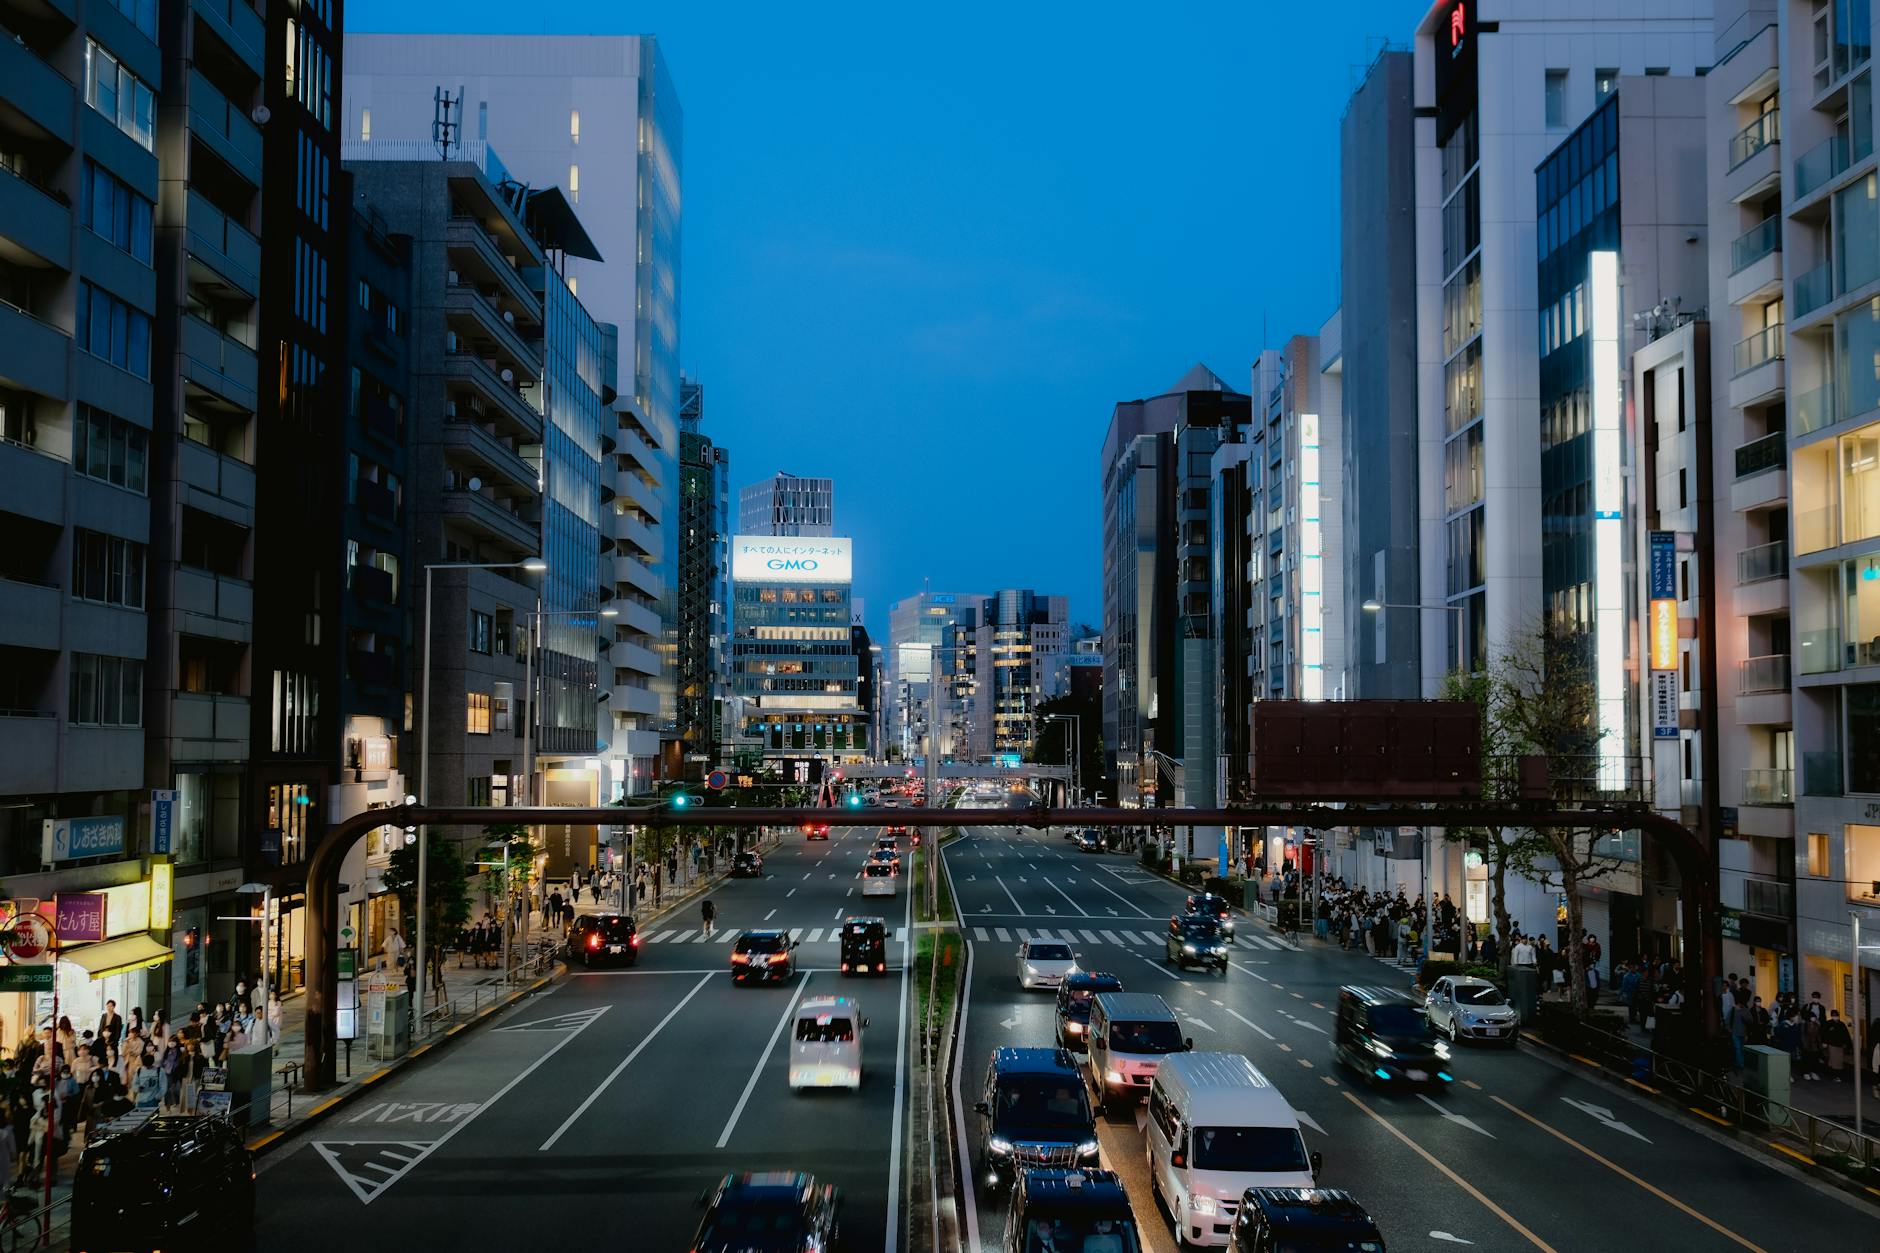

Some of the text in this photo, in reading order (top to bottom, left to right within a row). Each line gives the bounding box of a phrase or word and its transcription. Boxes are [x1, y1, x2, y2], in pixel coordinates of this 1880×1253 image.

[743, 546, 843, 556] すべての人にインターネット
[767, 559, 818, 571] GMO
[1660, 728, 1673, 736] 3F
[1864, 803, 1880, 819] JP
[72, 824, 123, 849] しおざき内科
[57, 910, 100, 932] たんす屋
